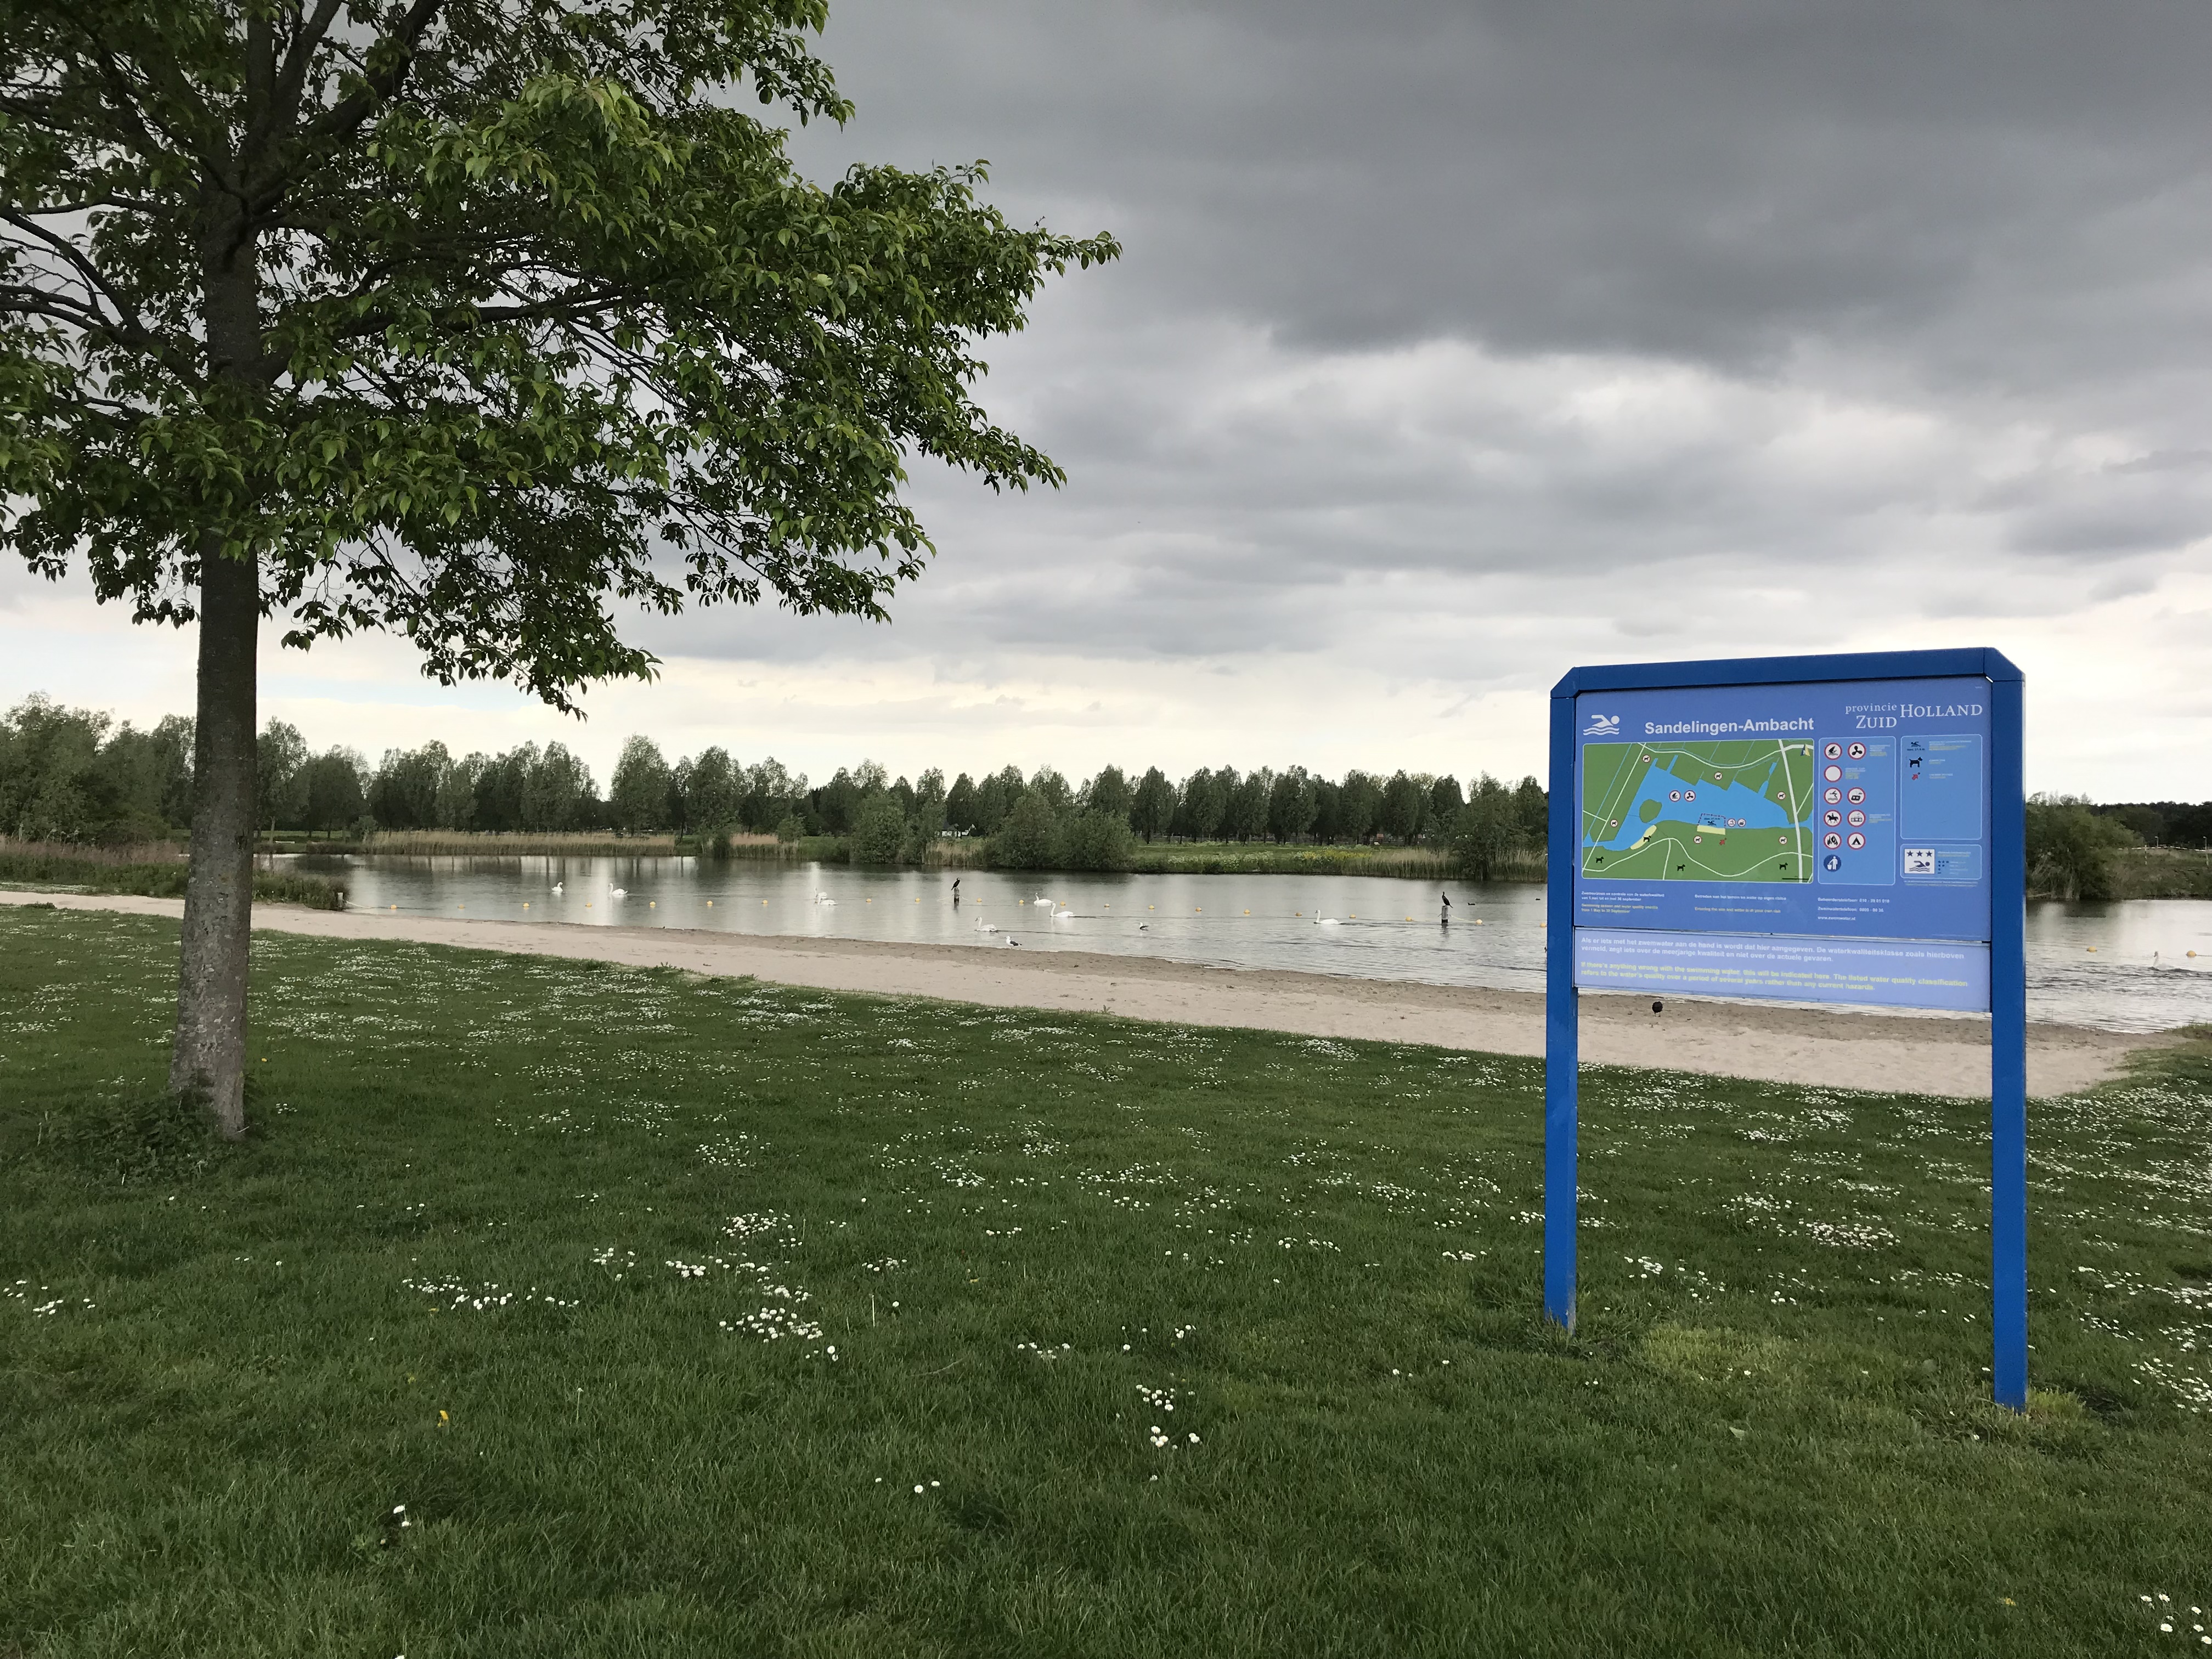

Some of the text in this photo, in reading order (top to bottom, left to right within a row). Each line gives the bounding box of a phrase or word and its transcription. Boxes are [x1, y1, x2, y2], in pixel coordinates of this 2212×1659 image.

[1845, 702, 1897, 715] provincie
[1856, 704, 1983, 729] ZUID HOLLAND
[1645, 718, 1814, 735] Sandelingen-Ambacht
[1828, 947, 1903, 956] waterkwaliteitsklasse
[1892, 977, 1916, 985] quality
[1918, 978, 1967, 986] classification
